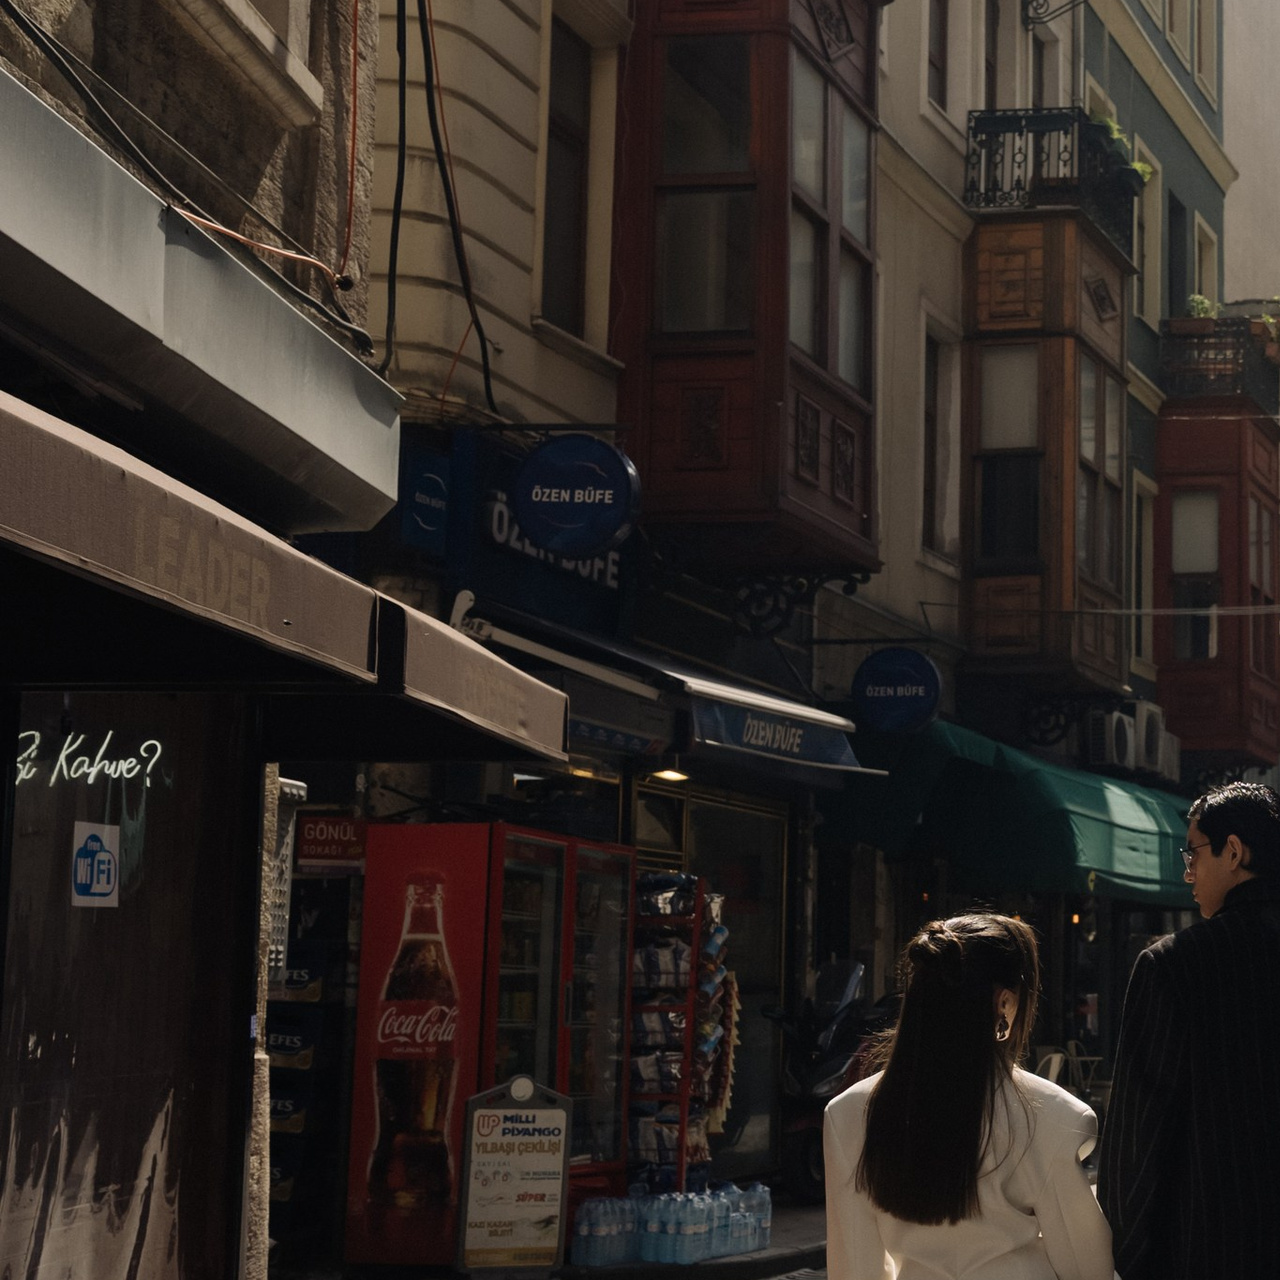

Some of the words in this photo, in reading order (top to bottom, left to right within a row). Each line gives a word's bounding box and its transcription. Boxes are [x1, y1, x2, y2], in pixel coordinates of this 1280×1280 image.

[531, 485, 571, 504] ÖZEN
[573, 486, 615, 505] BÜFE
[135, 504, 271, 632] LEADER
[866, 685, 894, 697] ÖZEN
[897, 684, 925, 697] BÜFE
[742, 712, 774, 747] ÖZEN
[773, 721, 804, 753] BÜFE
[304, 821, 357, 841] GÖNÜL
[303, 844, 342, 856] SOKAĞI
[77, 857, 91, 884] Wi
[97, 859, 111, 885] Fi
[287, 969, 309, 981] FES
[377, 1004, 459, 1044] Coca-Cola
[269, 1033, 302, 1049] EFES
[271, 1099, 294, 1112] FES
[502, 1126, 562, 1137] PİYANGO
[475, 1141, 515, 1156] YILBAŞI
[517, 1140, 561, 1156] ÇEKİLİŞİ
[515, 1191, 547, 1203] SÜPER
